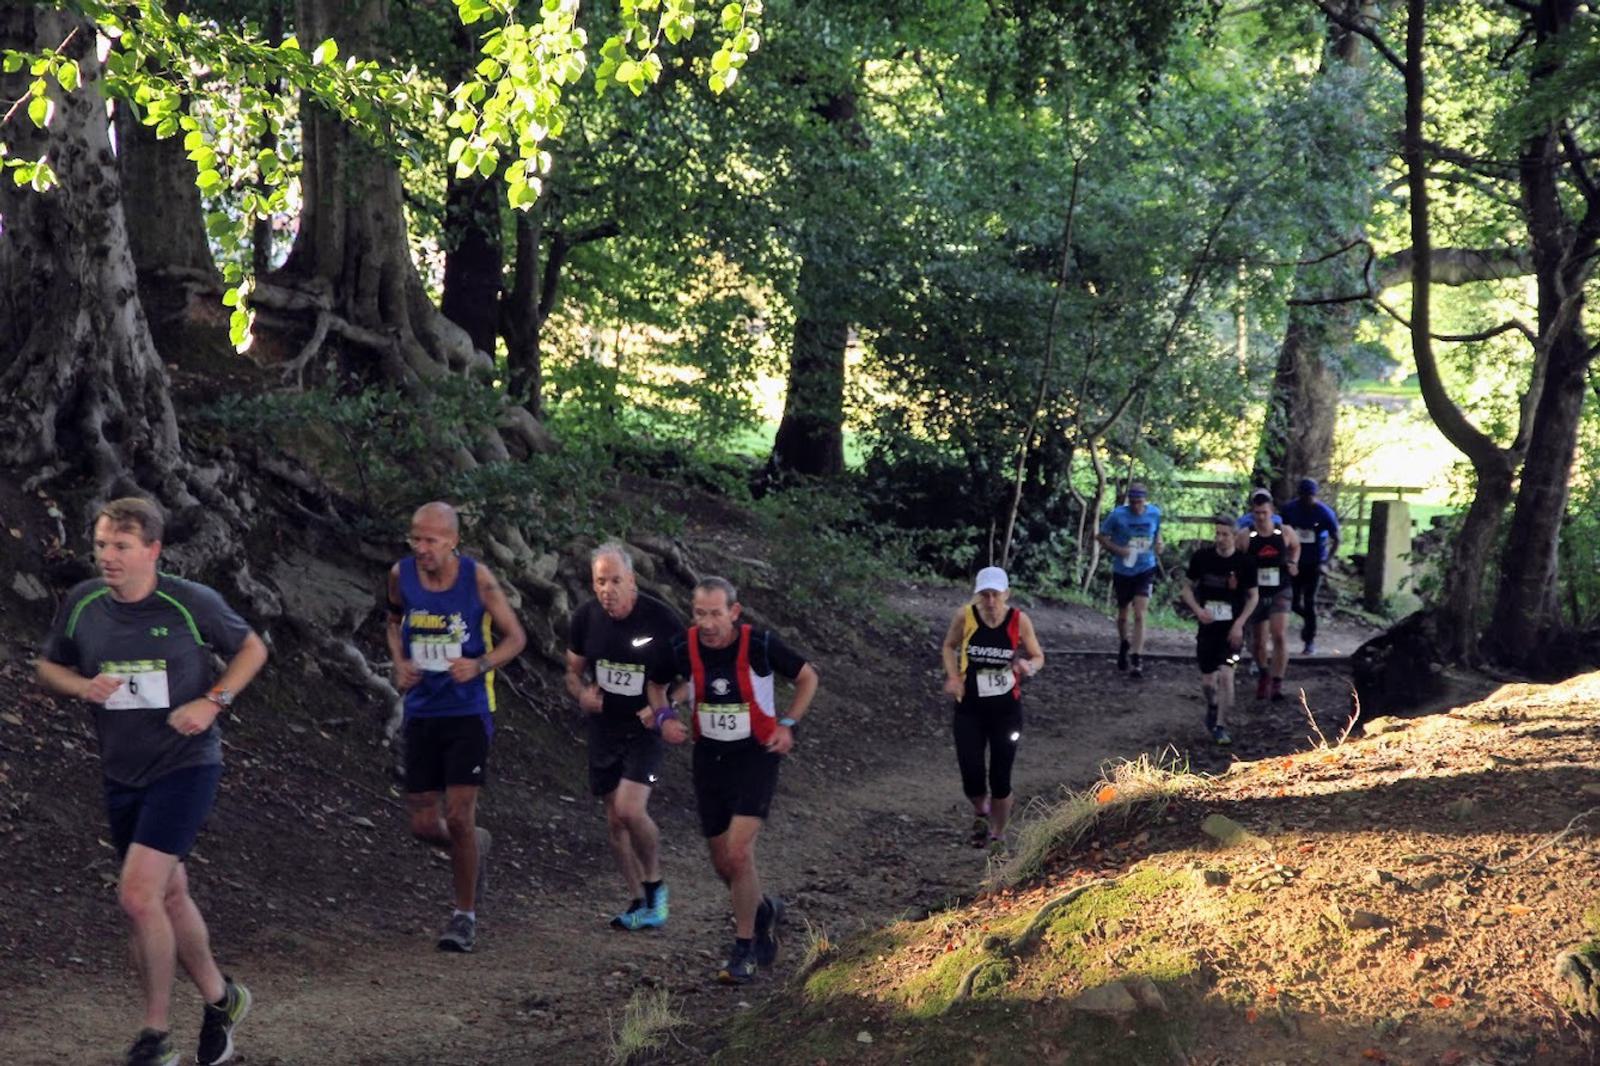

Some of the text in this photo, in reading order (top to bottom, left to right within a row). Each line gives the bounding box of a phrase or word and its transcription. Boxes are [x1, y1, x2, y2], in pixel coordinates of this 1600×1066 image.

[129, 675, 138, 695] 6
[607, 670, 632, 687] 122
[710, 713, 737, 731] 143
